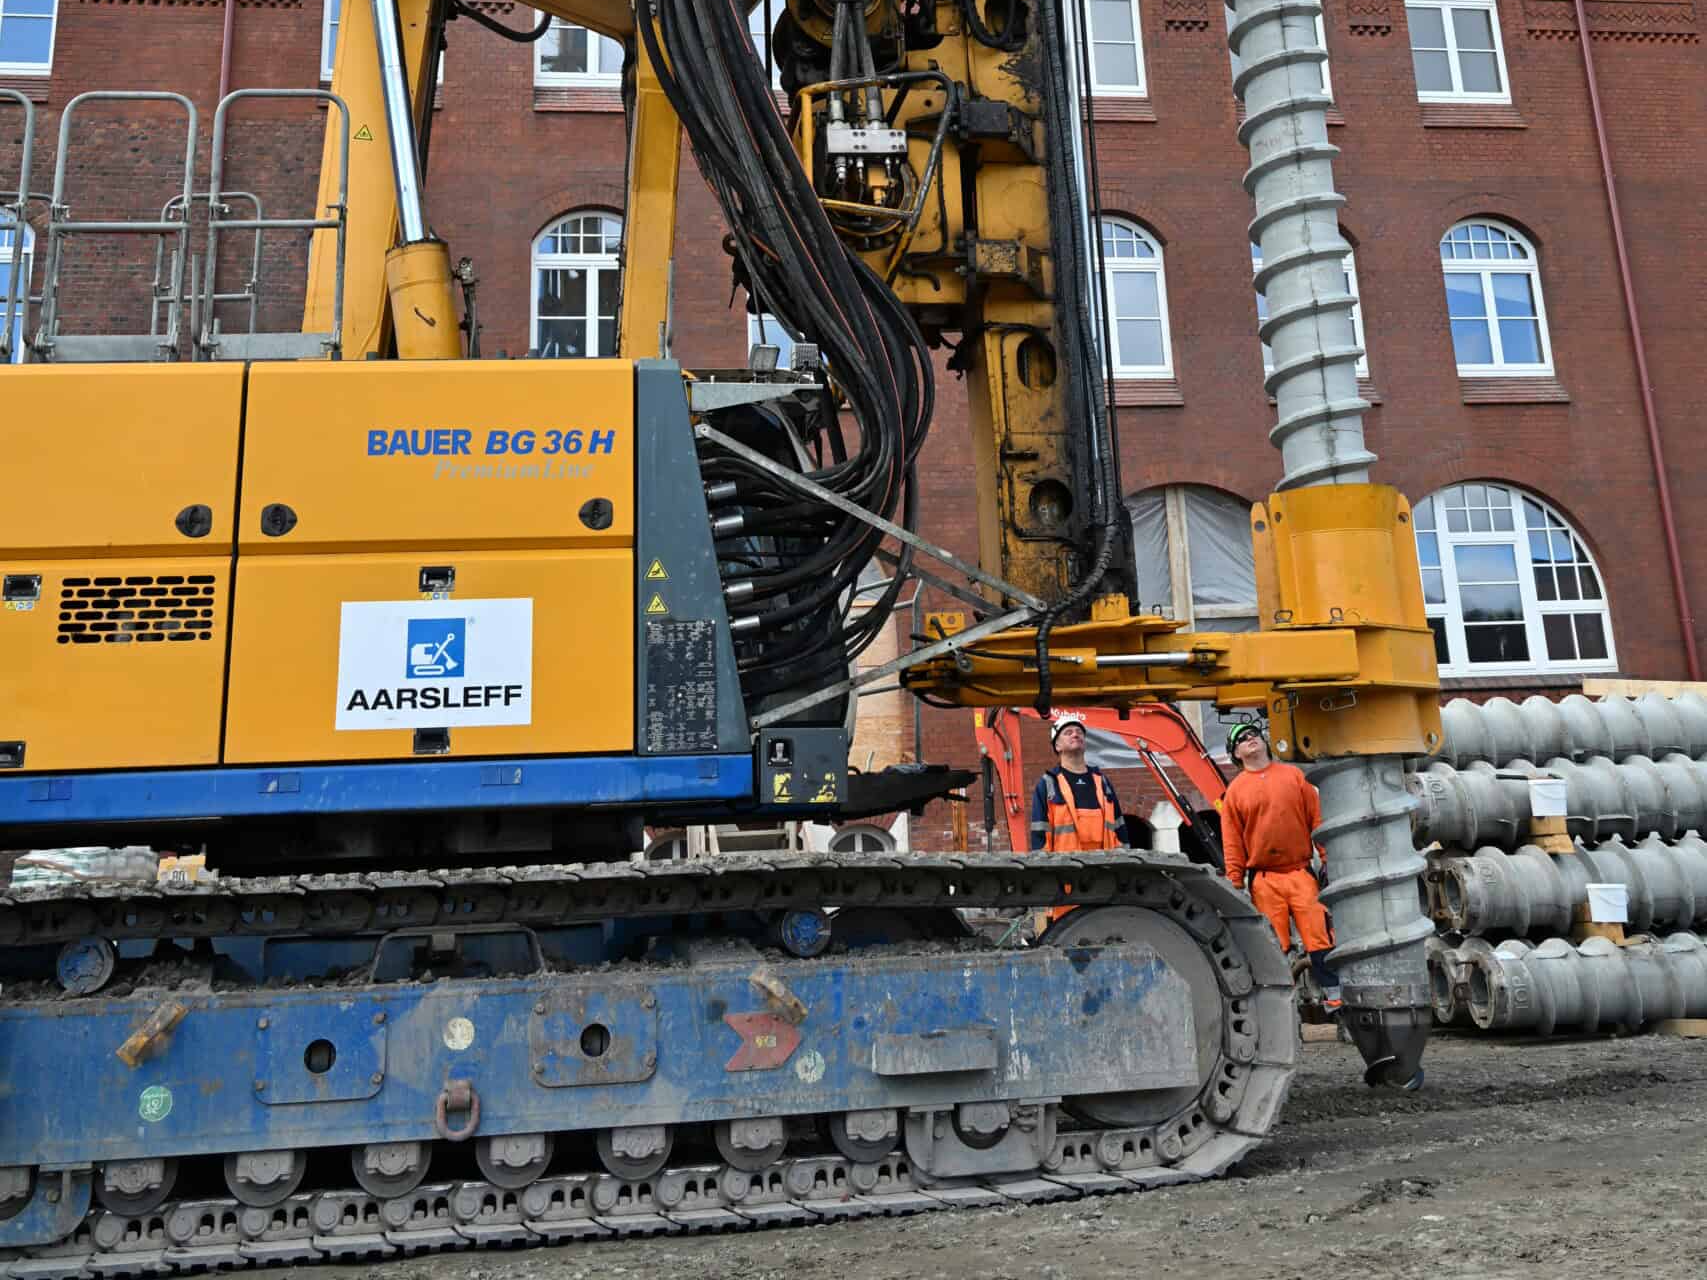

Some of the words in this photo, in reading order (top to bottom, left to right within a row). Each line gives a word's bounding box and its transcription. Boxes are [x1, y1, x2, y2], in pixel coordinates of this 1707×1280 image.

[367, 429, 472, 456] BAUER
[485, 430, 536, 455] BG
[541, 430, 584, 455] 36
[588, 430, 616, 454] H
[346, 684, 523, 711] AARSLEFF
